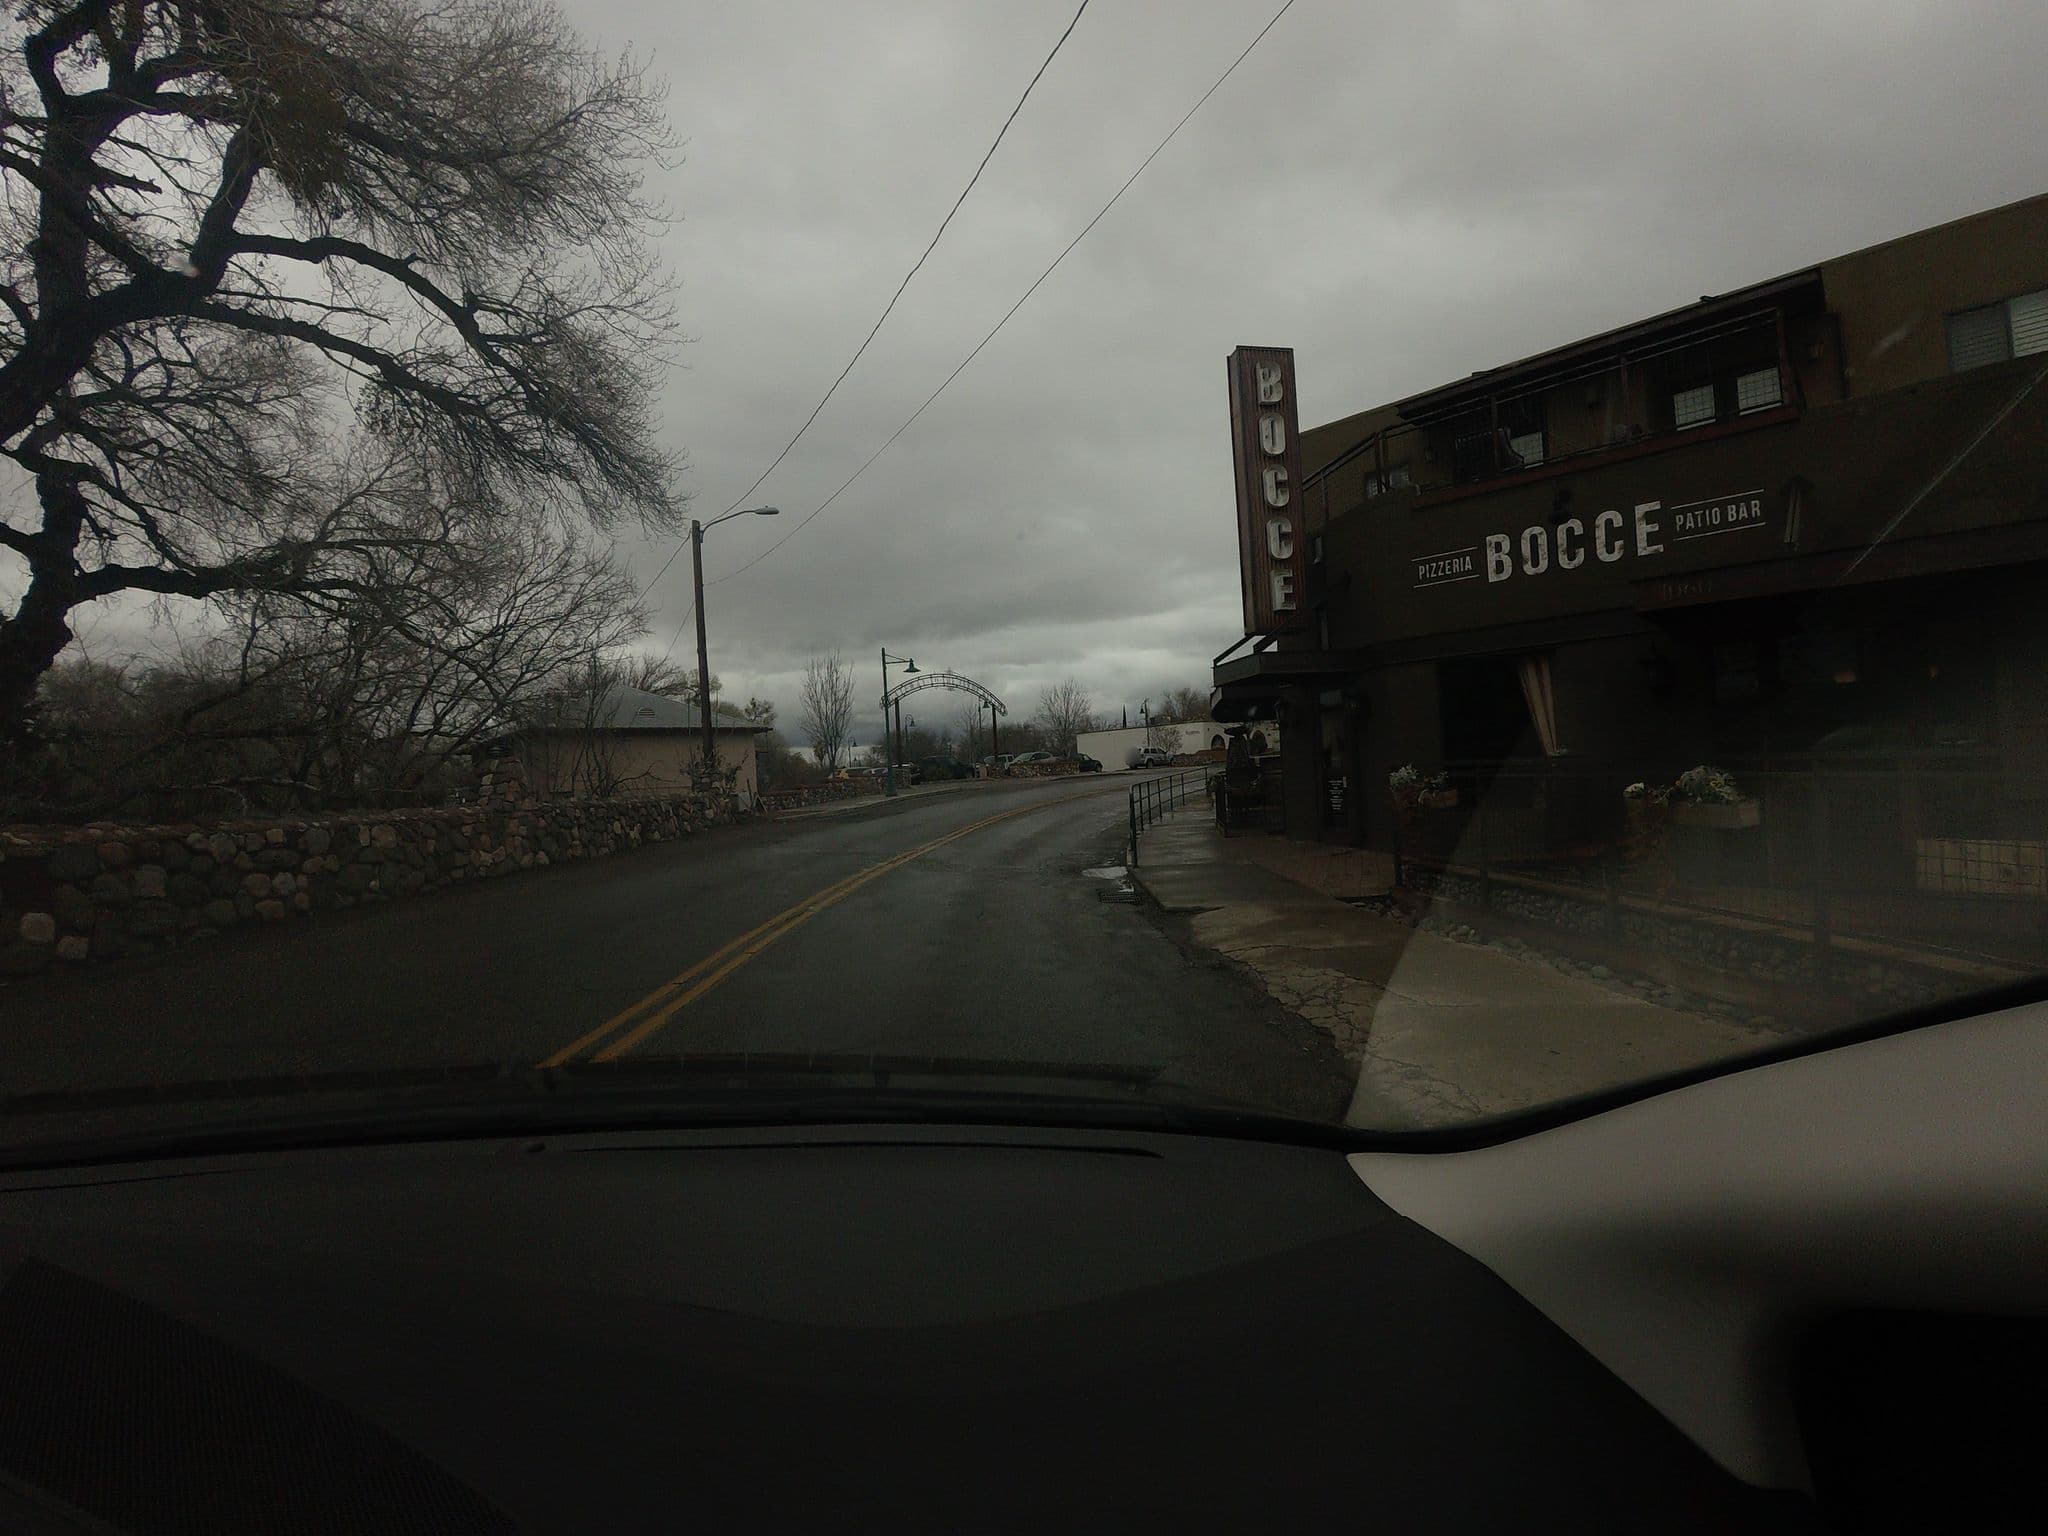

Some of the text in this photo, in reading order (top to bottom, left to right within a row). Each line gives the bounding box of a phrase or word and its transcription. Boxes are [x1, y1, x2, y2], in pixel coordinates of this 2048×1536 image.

[1255, 361, 1296, 611] BOCCE
[1418, 500, 1762, 583] PIZZERIA BOCCE PATIO BAR
